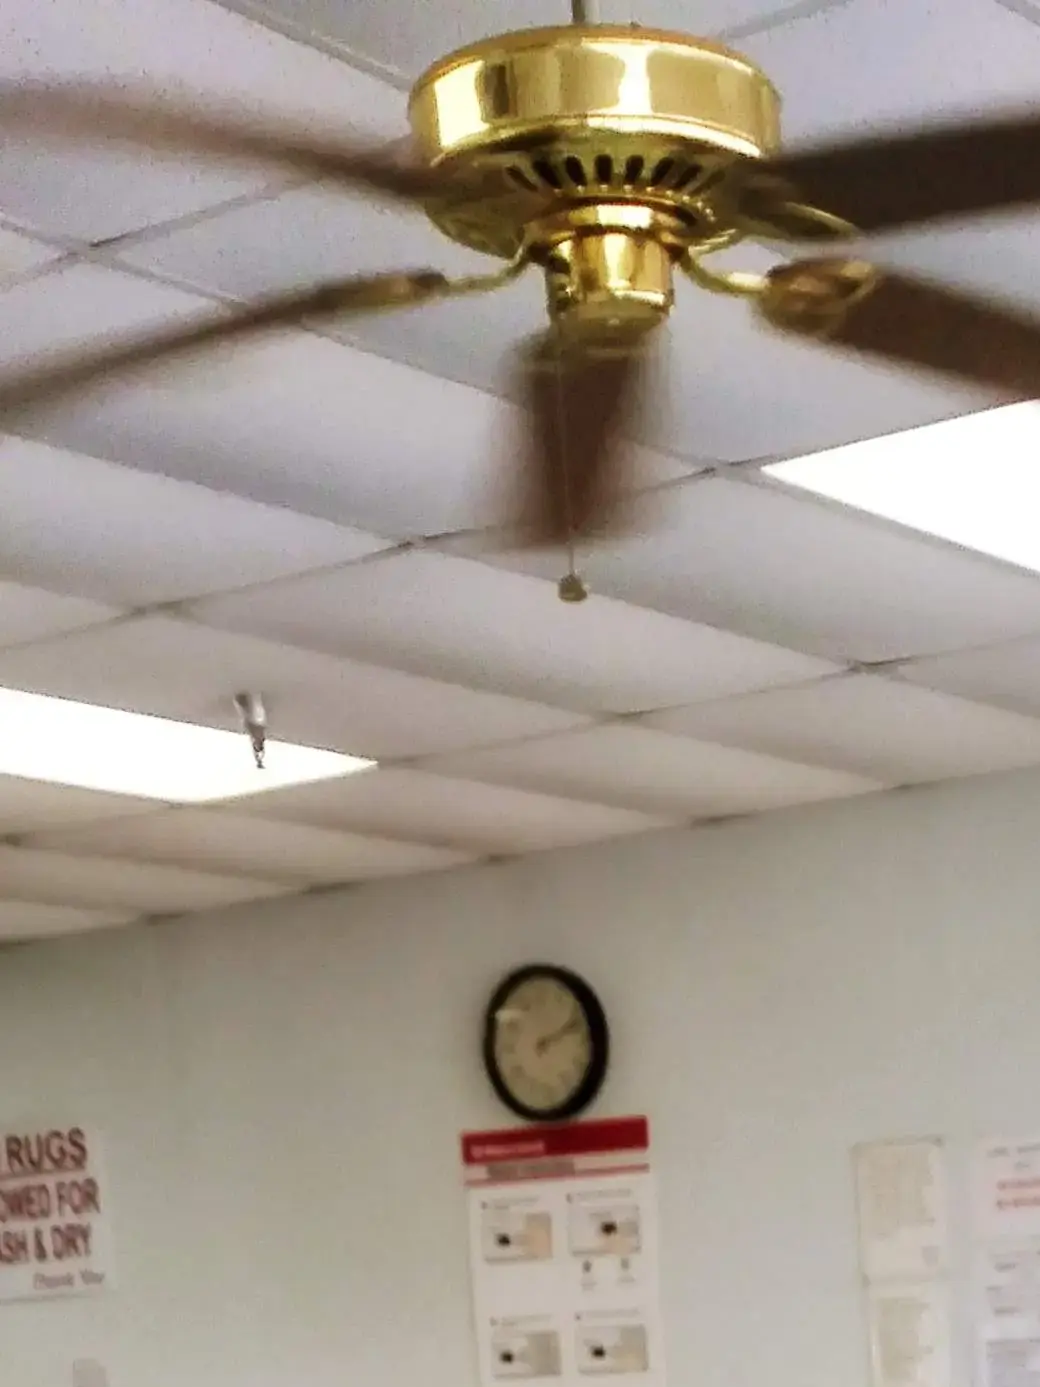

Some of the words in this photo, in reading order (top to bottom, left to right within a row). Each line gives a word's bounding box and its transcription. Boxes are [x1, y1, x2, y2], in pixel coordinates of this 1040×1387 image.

[5, 1127, 88, 1176] RUGS
[56, 1177, 101, 1218] FOR
[50, 1223, 91, 1260] DRY
